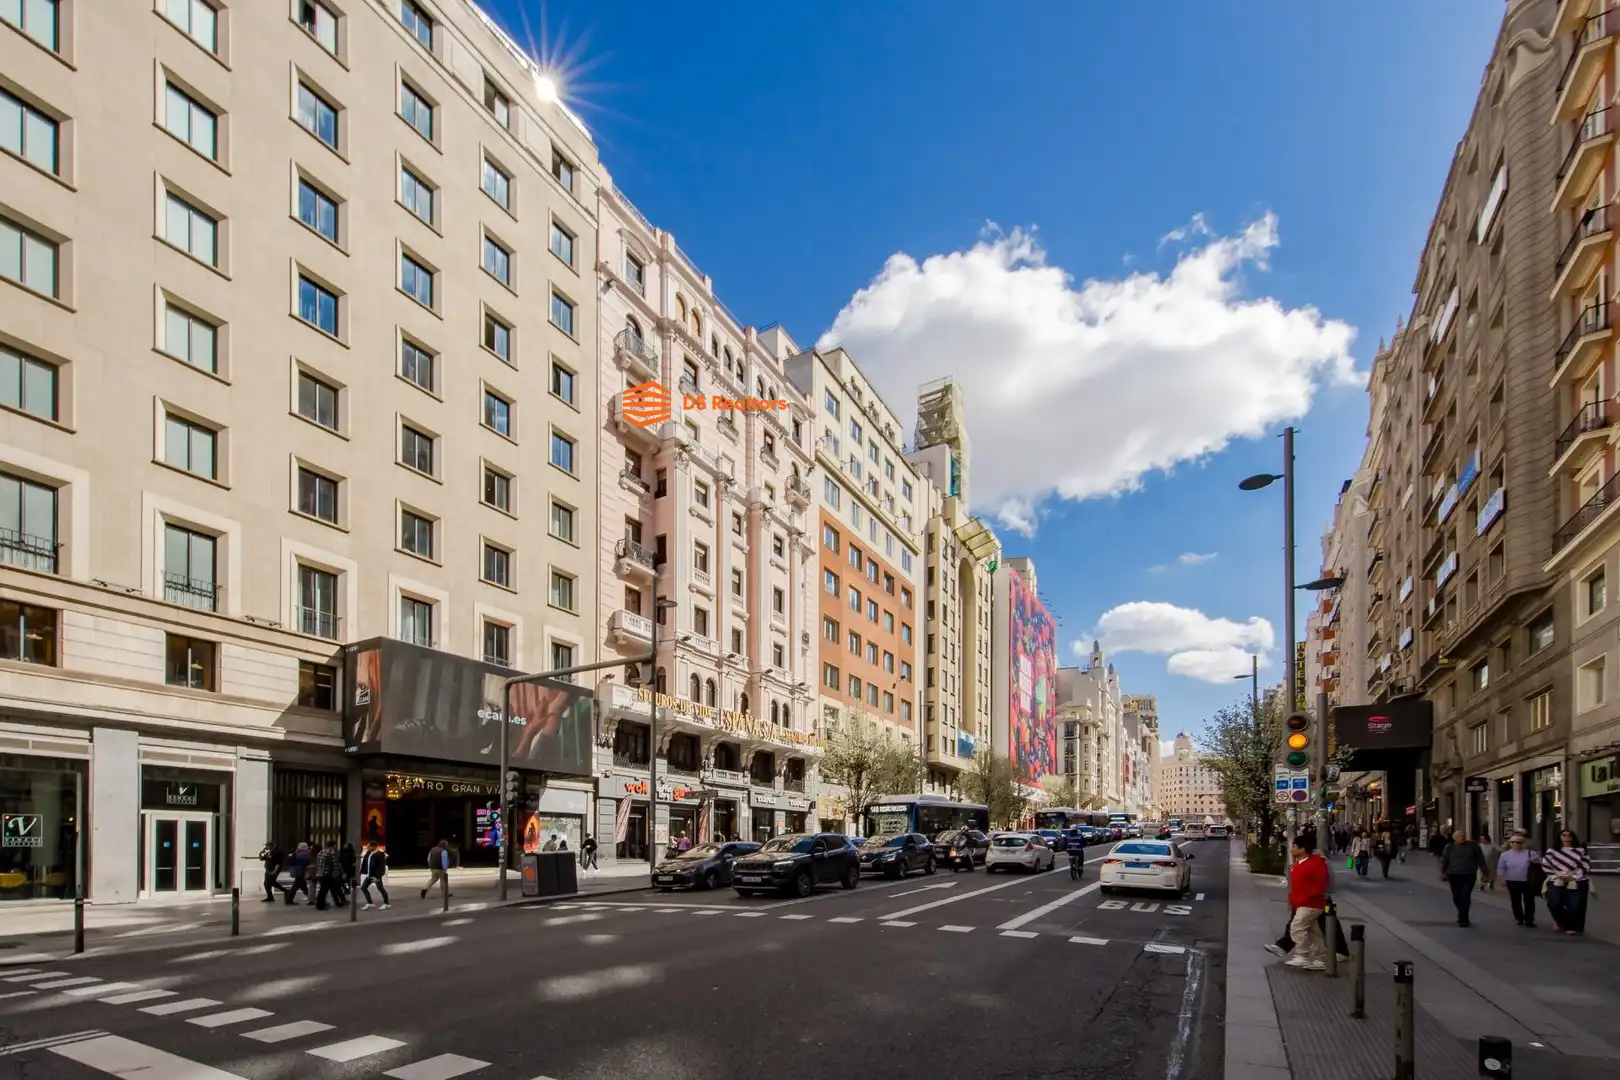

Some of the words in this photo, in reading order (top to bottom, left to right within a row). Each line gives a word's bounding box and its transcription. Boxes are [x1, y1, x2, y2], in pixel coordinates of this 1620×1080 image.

[398, 778, 444, 791] TEATRO
[451, 783, 480, 793] GRAN
[1097, 900, 1193, 915] BUS
